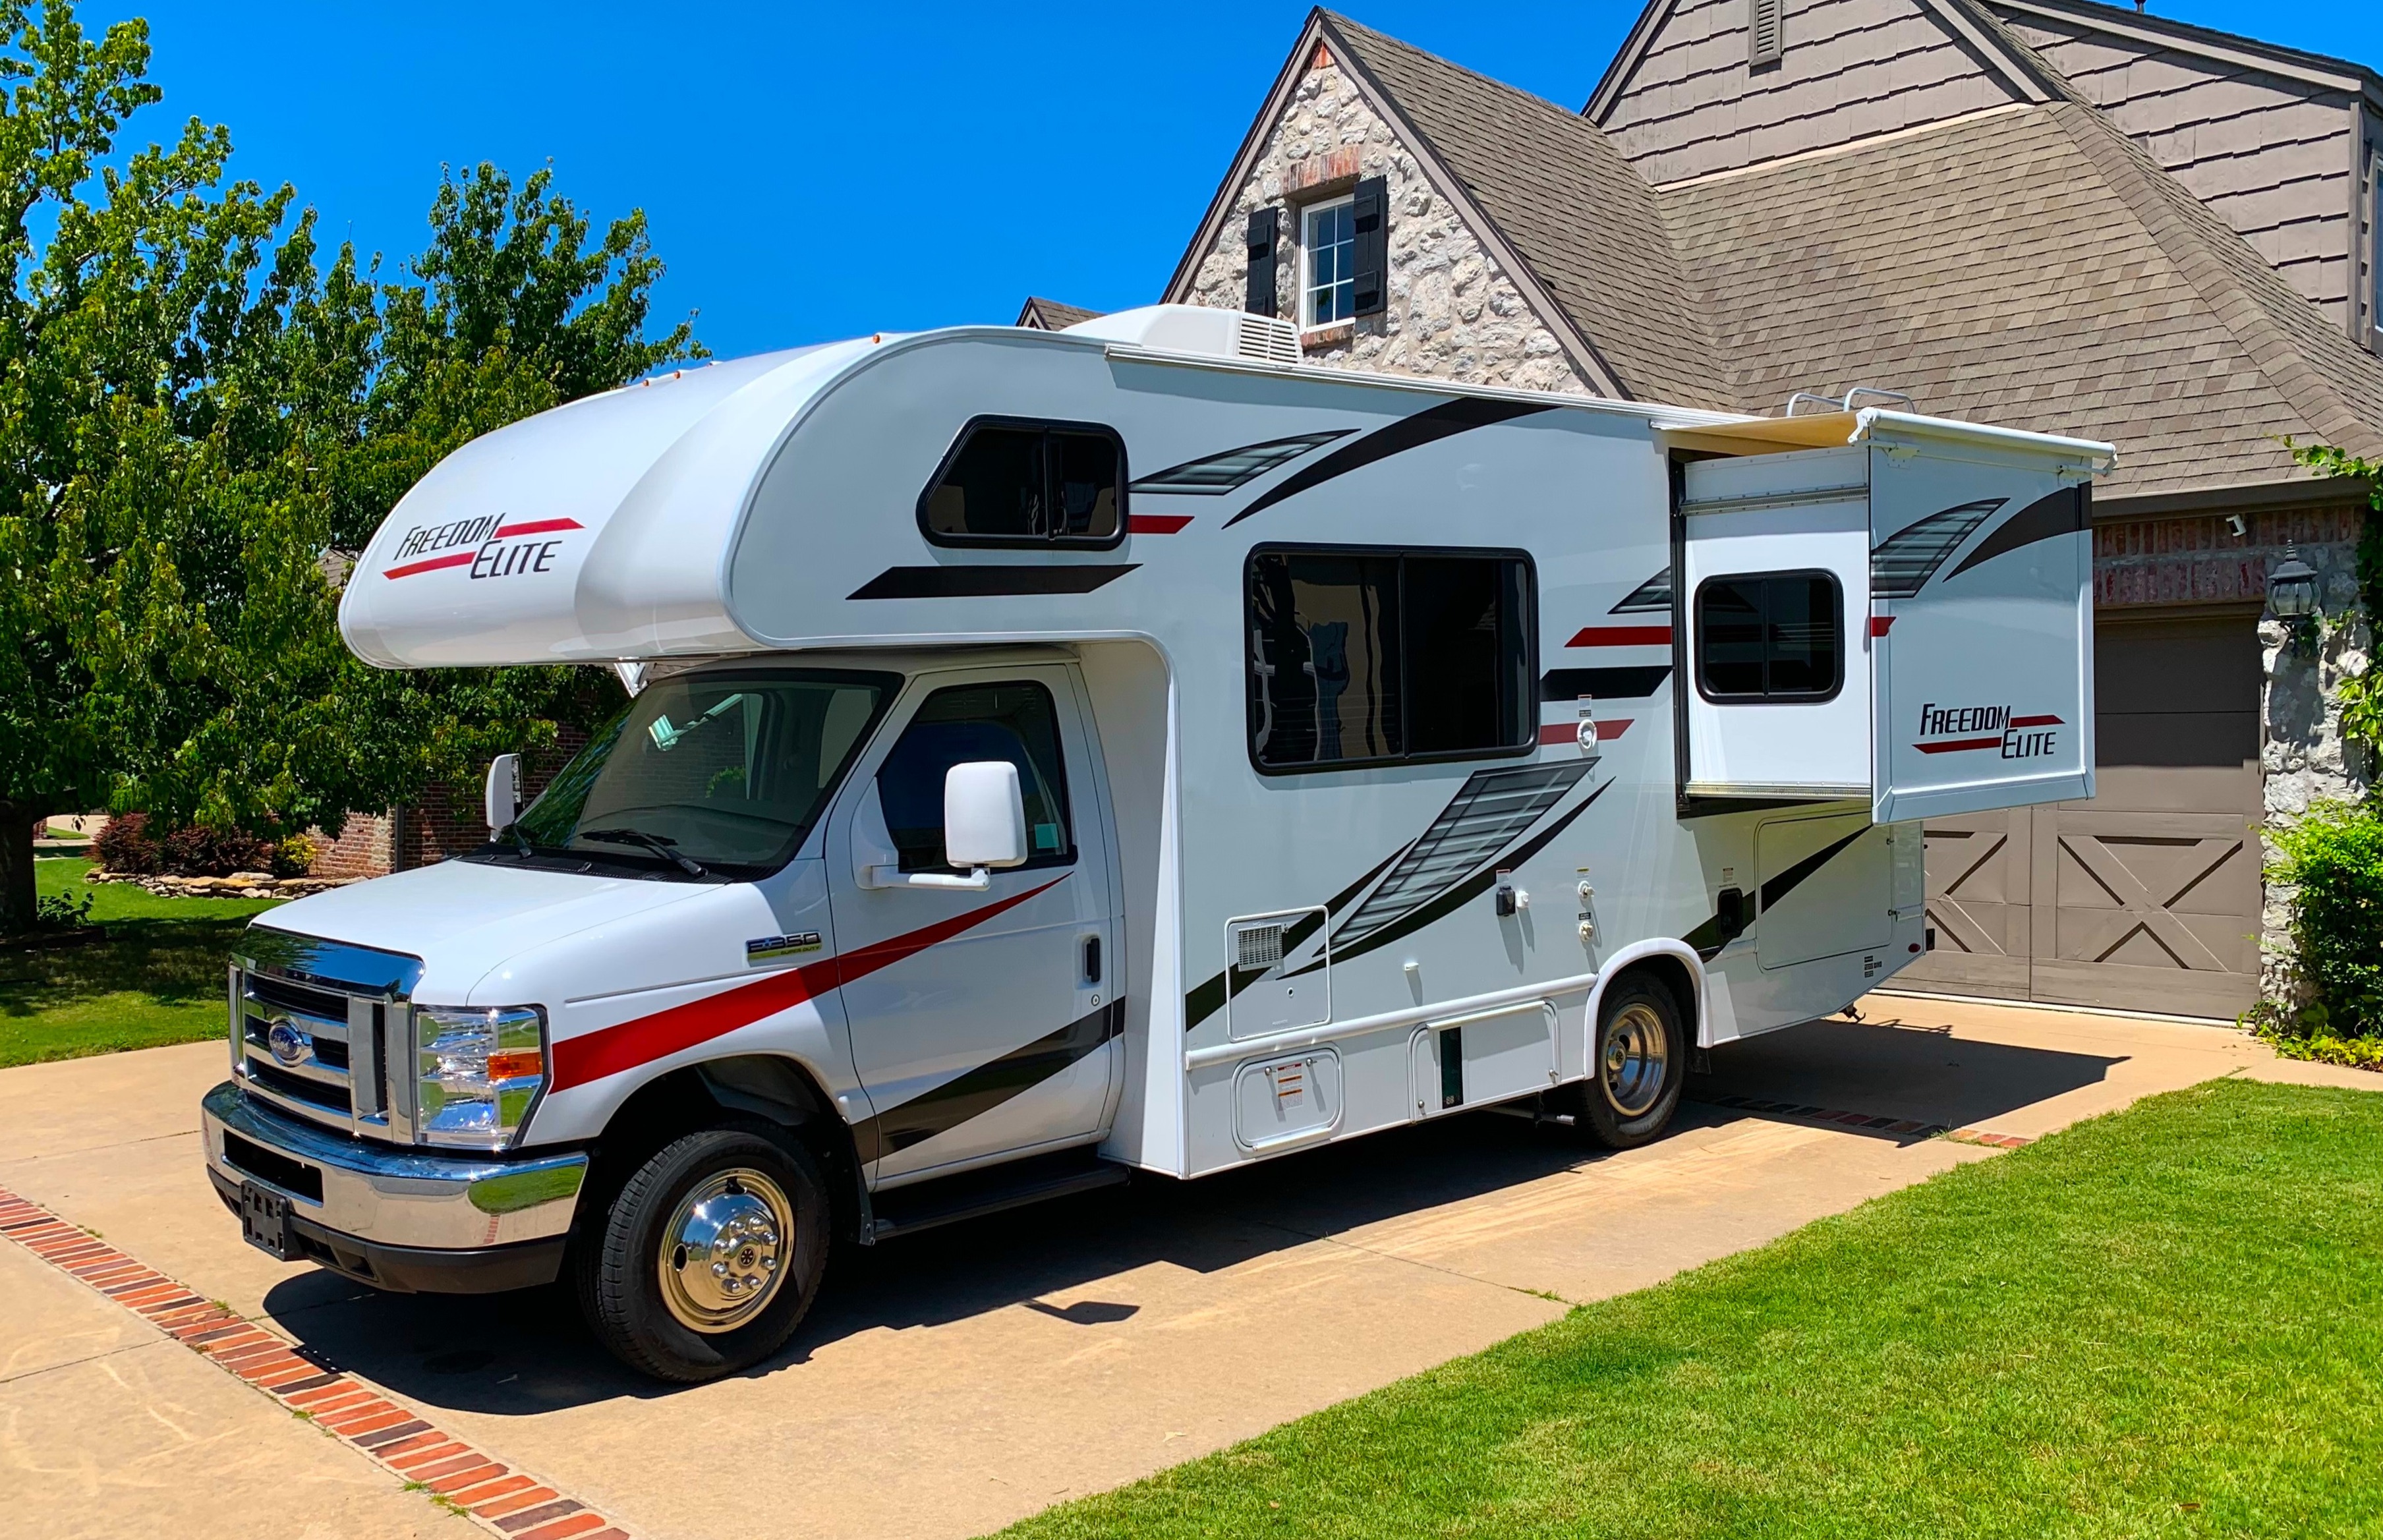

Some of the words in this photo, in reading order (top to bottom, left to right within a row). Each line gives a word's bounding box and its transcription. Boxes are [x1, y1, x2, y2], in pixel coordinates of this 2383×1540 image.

[393, 512, 507, 560] FREEDOM
[470, 540, 563, 579] ELITE
[1920, 703, 2011, 735] FREEDOM
[2001, 729, 2056, 759] ELITE
